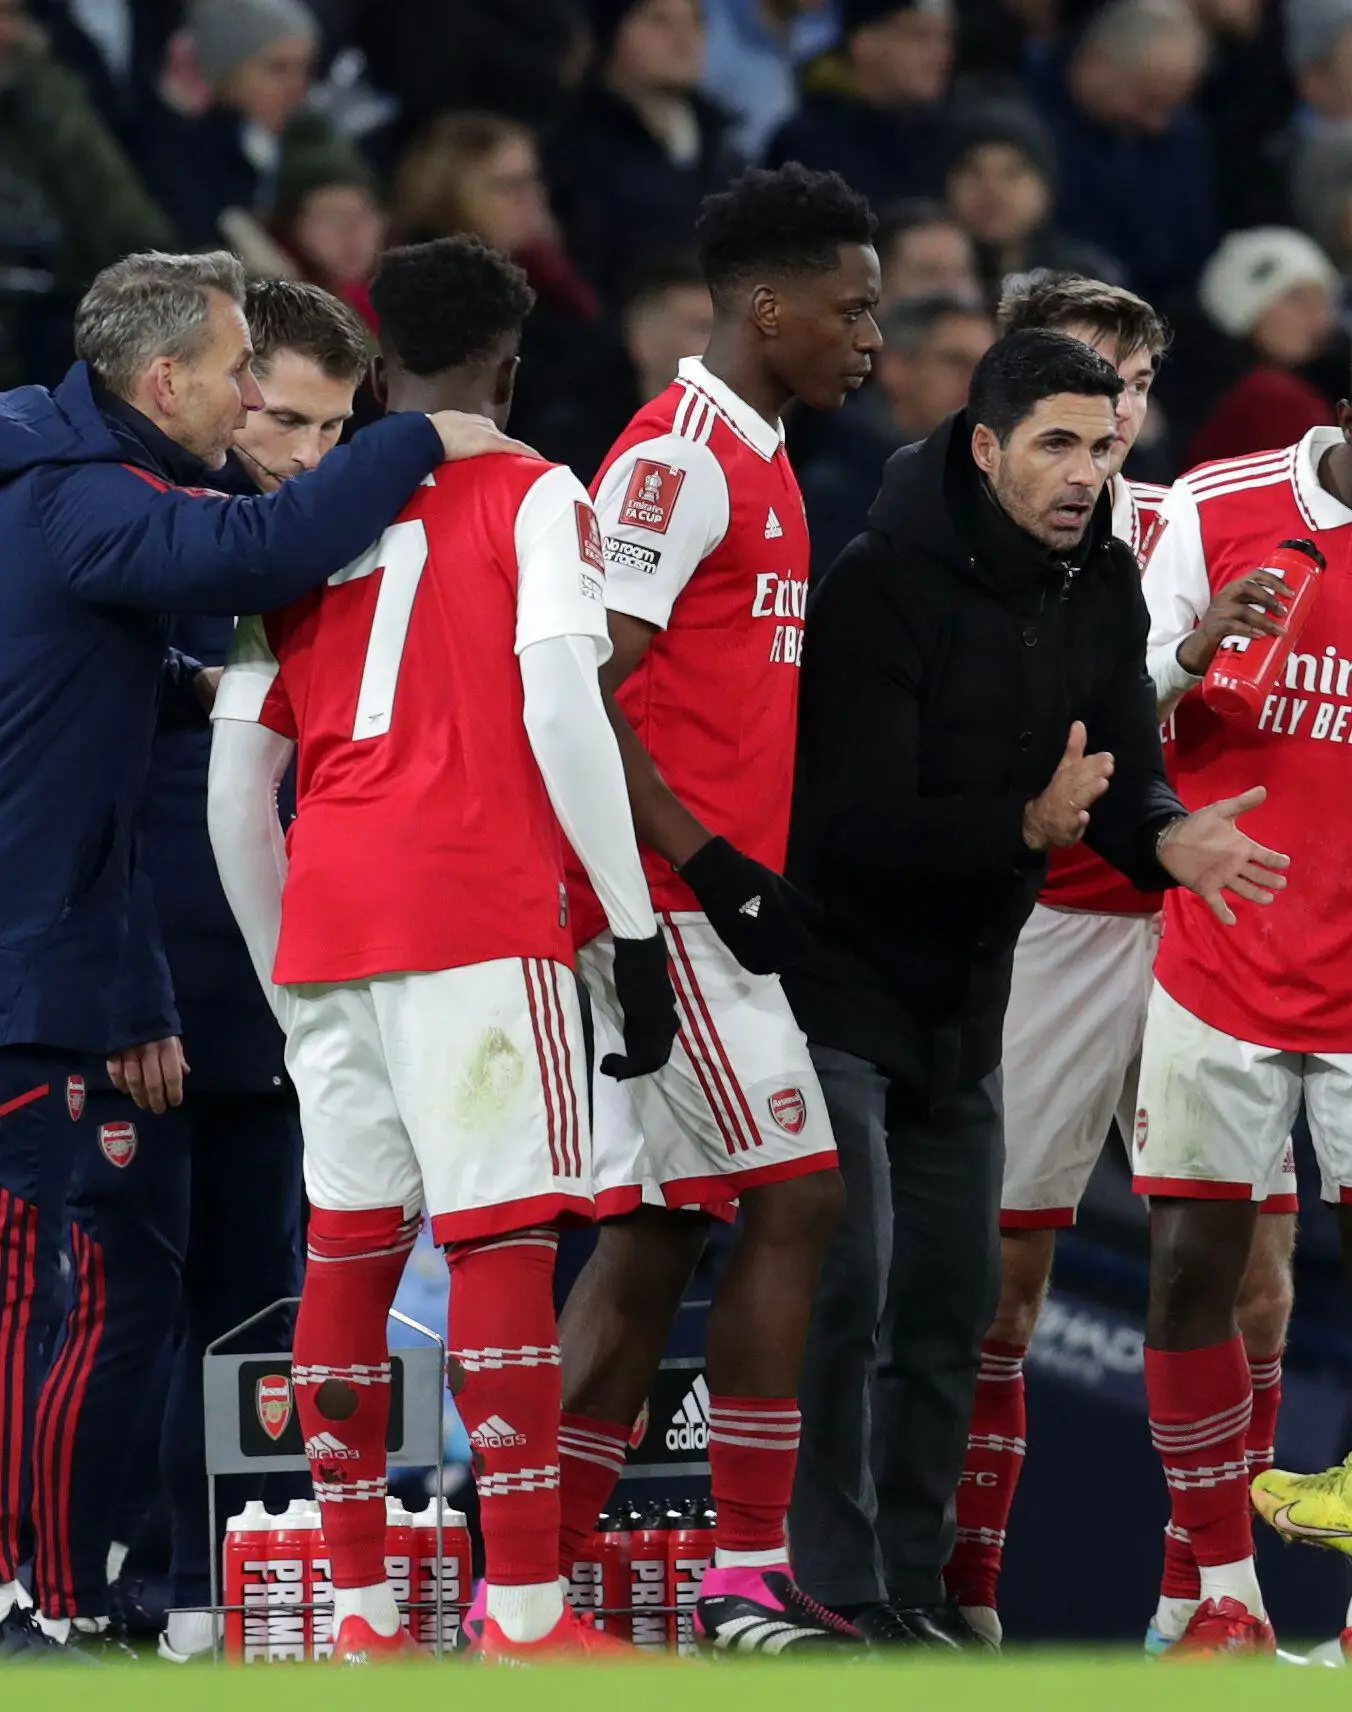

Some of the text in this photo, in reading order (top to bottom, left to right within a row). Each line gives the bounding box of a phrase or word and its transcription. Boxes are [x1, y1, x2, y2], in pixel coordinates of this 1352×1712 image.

[638, 511, 663, 523] CUP
[603, 537, 620, 551] No
[620, 543, 655, 562] room
[614, 553, 658, 574] racism
[328, 519, 429, 742] 7
[1257, 694, 1309, 735] FLY
[665, 1422, 711, 1451] adid
[957, 1471, 998, 1487] FC
[267, 1559, 304, 1663] PRIME
